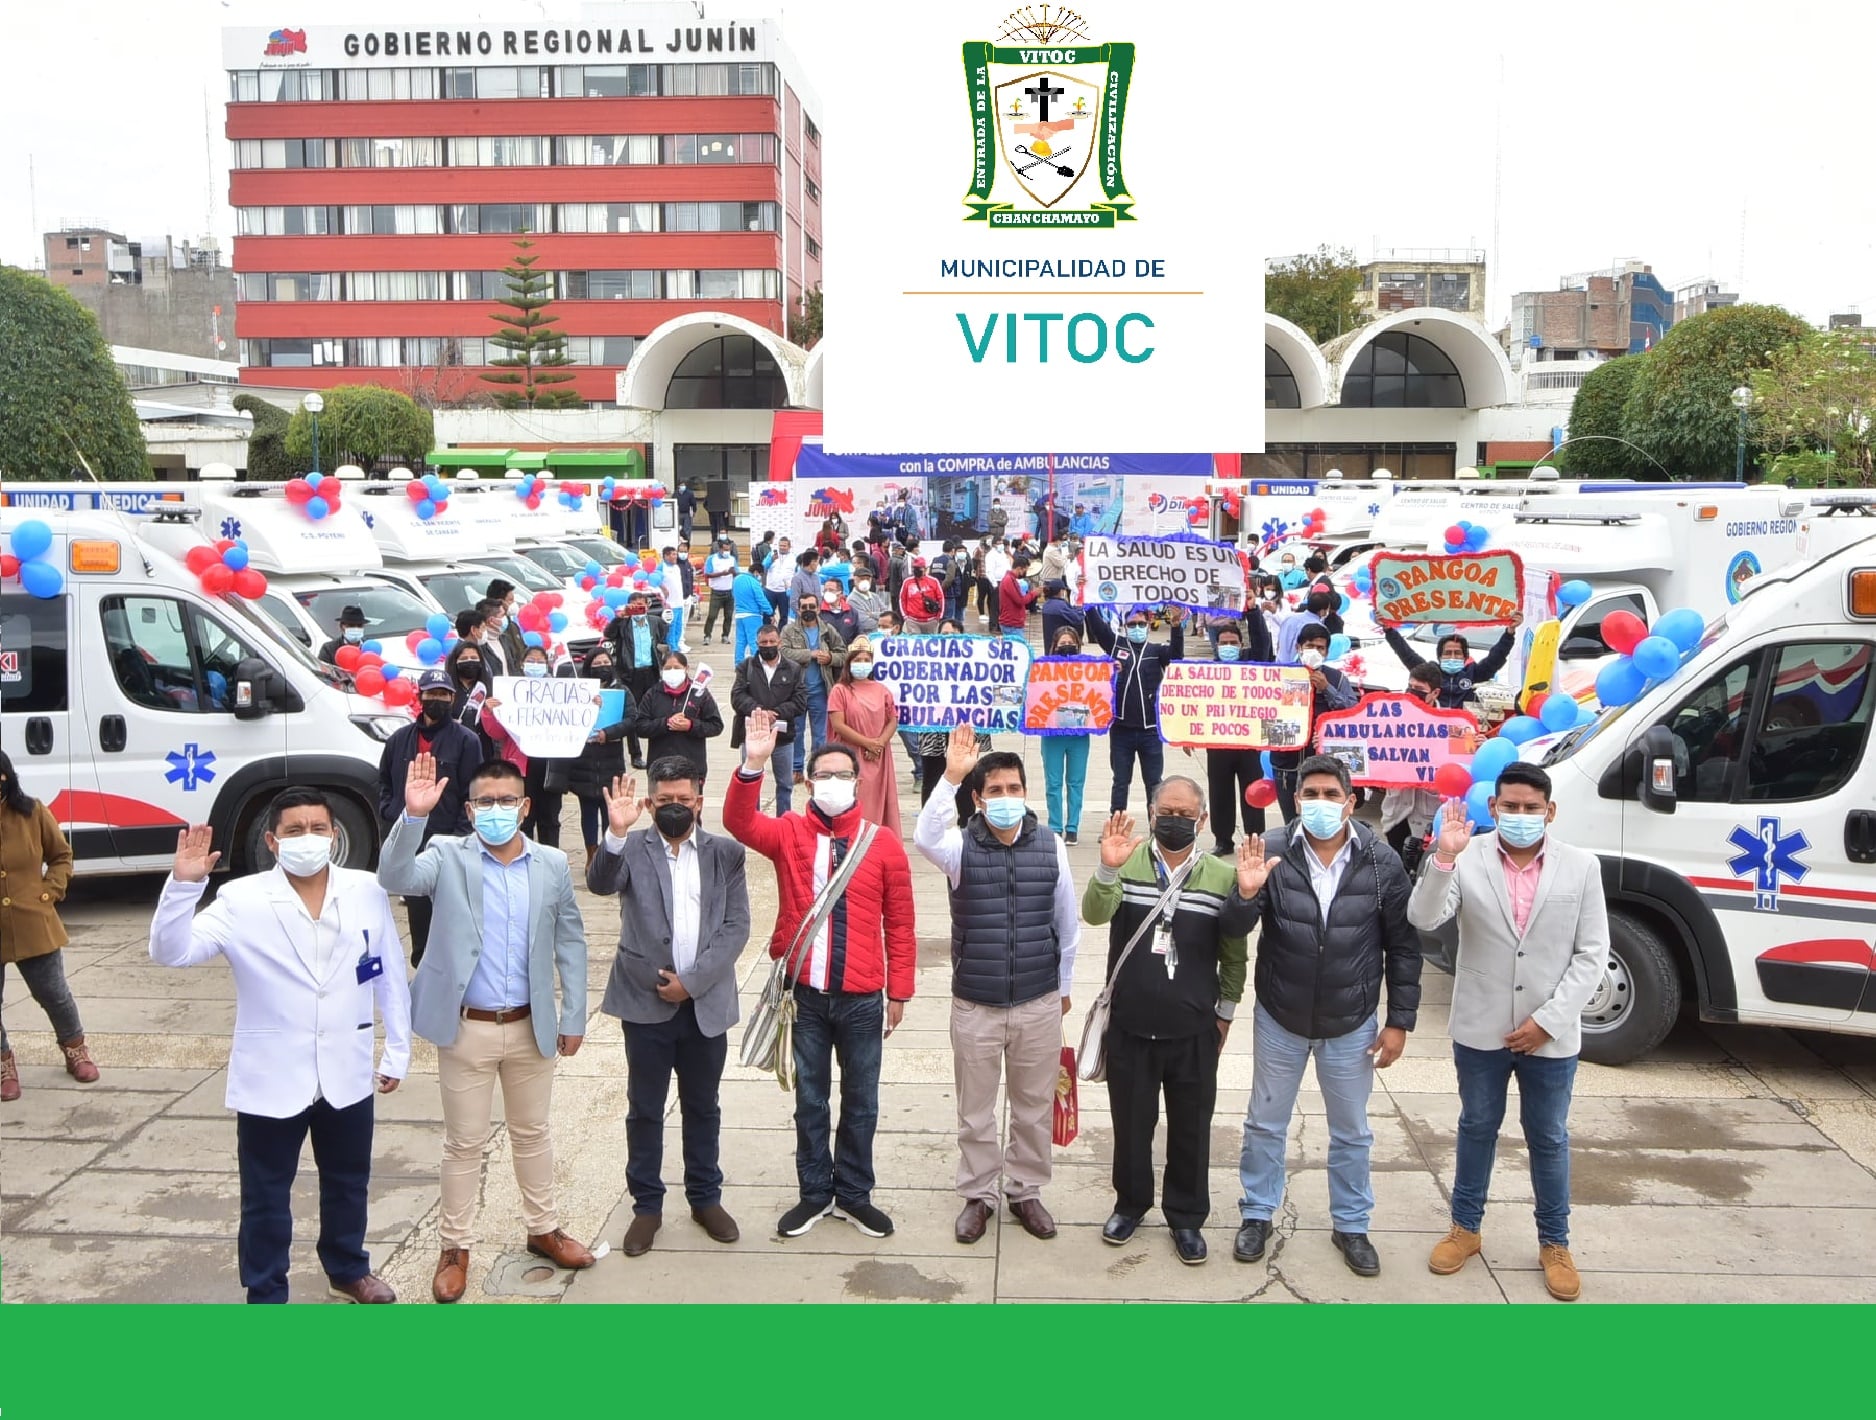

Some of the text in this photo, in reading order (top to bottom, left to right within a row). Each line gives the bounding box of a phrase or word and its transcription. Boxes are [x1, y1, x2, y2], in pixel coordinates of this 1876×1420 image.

[344, 21, 755, 57] GOBIERNO REGIONAL JUNÍN
[900, 456, 1110, 473] con la COMPRA de AMBULANCIAS
[1270, 486, 1310, 495] UNIDAD
[15, 493, 70, 509] UNIDAD
[1489, 503, 1500, 511] DE
[1726, 521, 1768, 536] GOBIERNO
[1089, 541, 1241, 567] LA SALUD ES UN
[1098, 565, 1220, 585] DERECHO DE
[1394, 560, 1498, 591] PANGOA
[1132, 586, 1199, 604] TODOS
[1384, 590, 1516, 620] PRESENTE
[881, 638, 1018, 660] GRACIAS SR.
[873, 660, 1016, 683] GOBERNADOR
[1029, 662, 1110, 683] PANGOA
[1166, 667, 1281, 682] LA SALUD ES UN
[513, 680, 591, 705] GRACIAS
[899, 683, 993, 706] POR LAS
[1161, 684, 1282, 700] DERECHO DE TODOS
[1026, 683, 1114, 729] PRESENTE
[1160, 703, 1175, 716] NO
[1181, 704, 1198, 717] UN
[1366, 702, 1402, 717] LAS
[517, 707, 592, 728] FERNANDO
[1189, 723, 1250, 737] DE POCOS
[1324, 723, 1448, 739] AMBULANCIAS
[1367, 746, 1430, 763] SALVAN
[1416, 767, 1440, 782] VI
